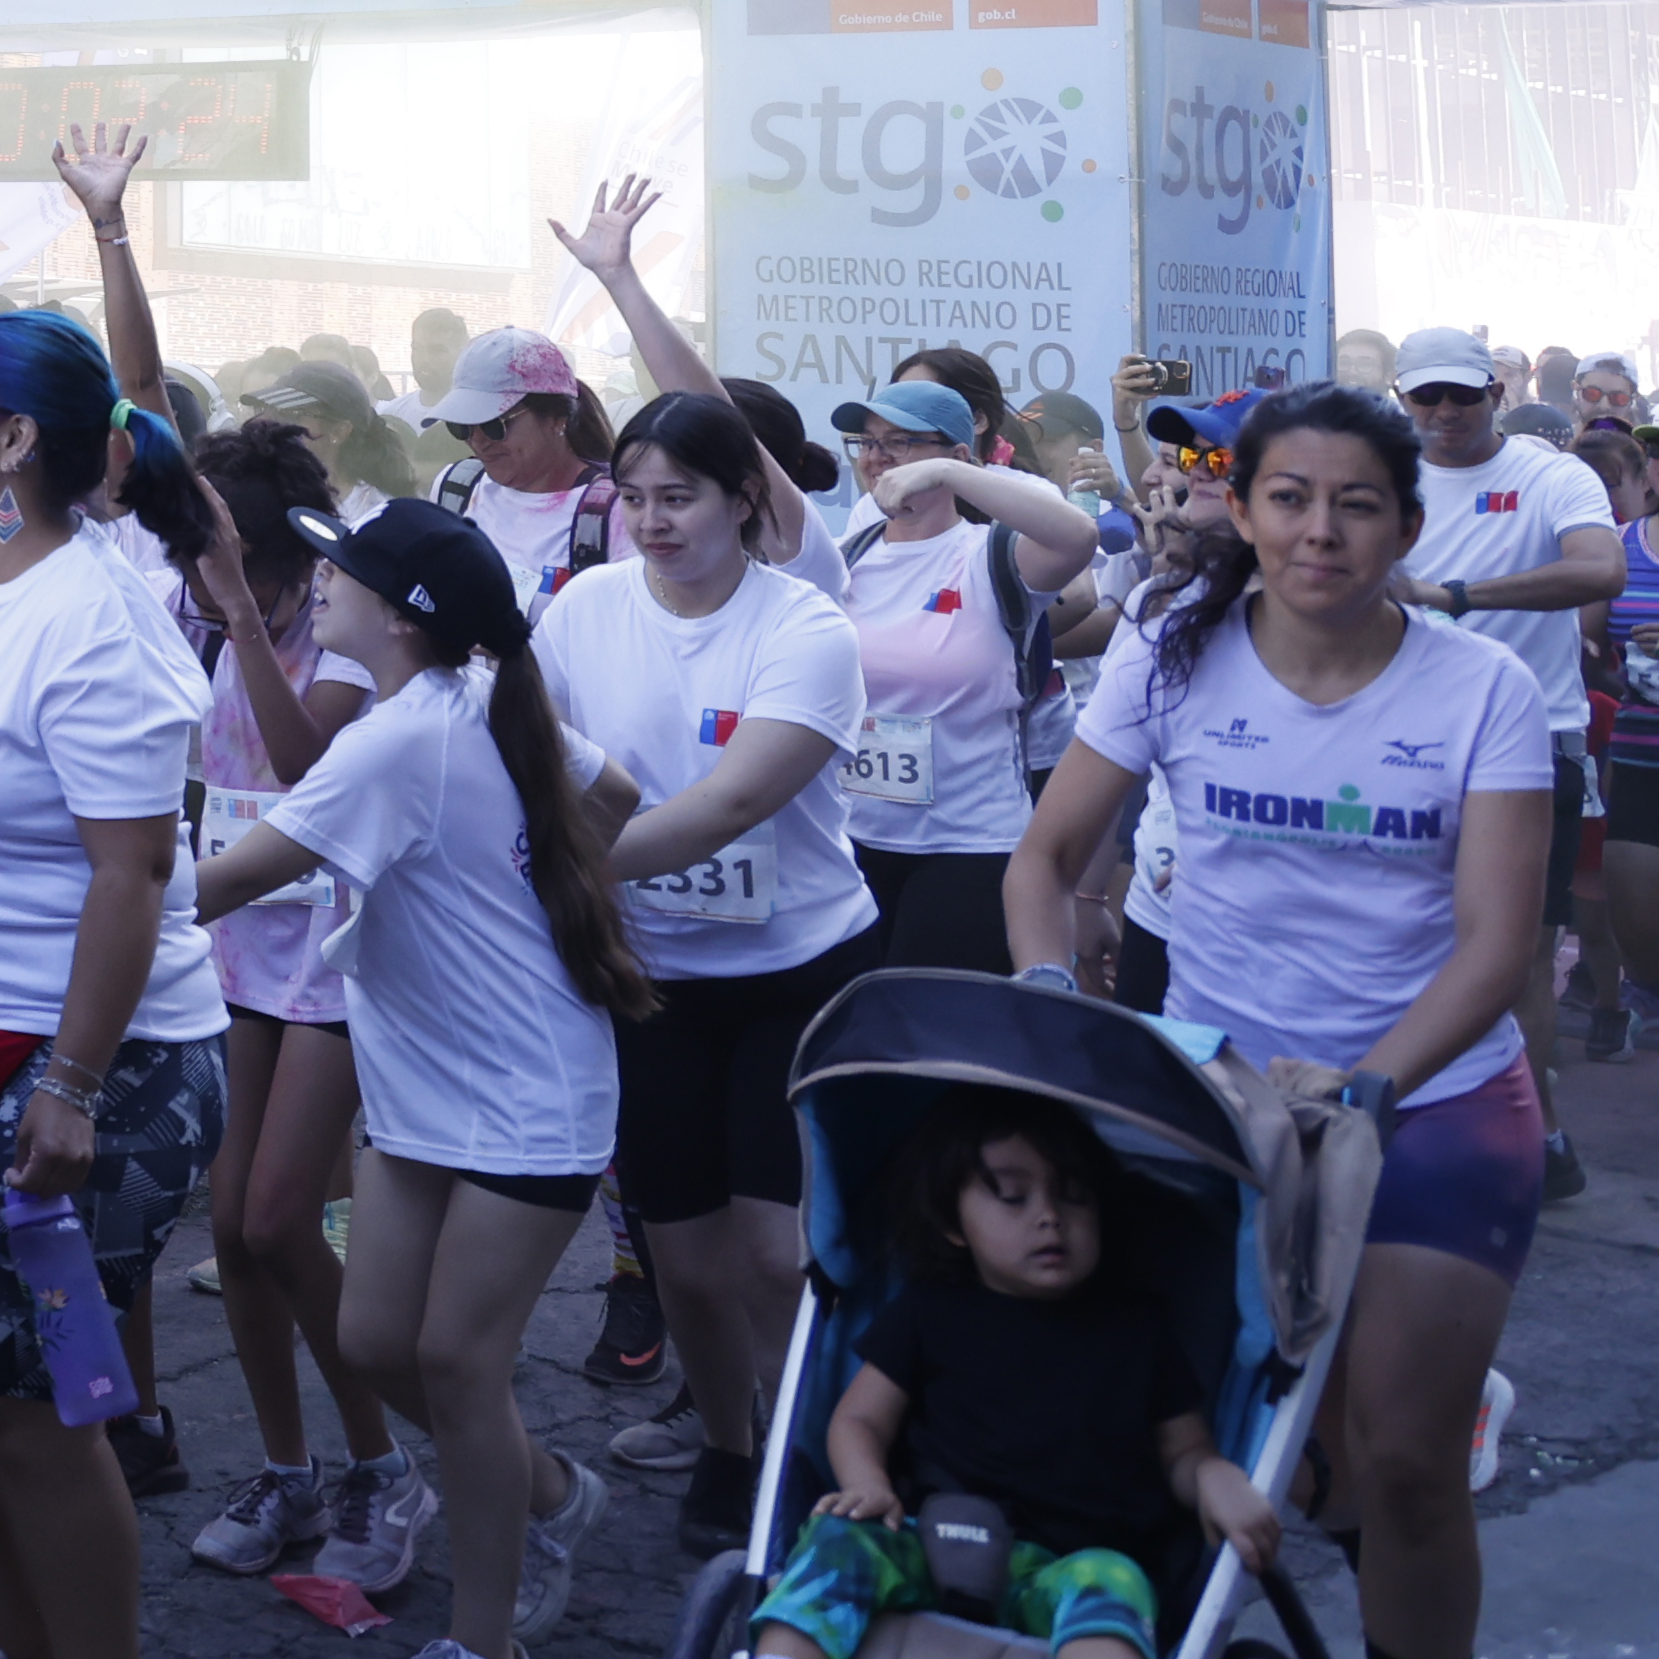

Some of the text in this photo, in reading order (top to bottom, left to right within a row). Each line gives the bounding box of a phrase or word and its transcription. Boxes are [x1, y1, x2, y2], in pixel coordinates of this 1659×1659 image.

[839, 9, 944, 26] Gobierno de Chile
[978, 7, 1018, 24] gob.cl
[618, 141, 689, 177] Chile se
[754, 254, 1072, 292] GOBIERNO REGIONAL
[1157, 261, 1306, 300] GOBIERNO REGIONAL
[755, 293, 1072, 332] METROPOLITANO DE
[1157, 302, 1307, 338] METROPOLITANO DE
[755, 331, 1076, 394] SANTGO
[1203, 729, 1270, 744] UNLIMITED
[1204, 781, 1442, 840] IRONMAN
[935, 1522, 989, 1544] THULE
